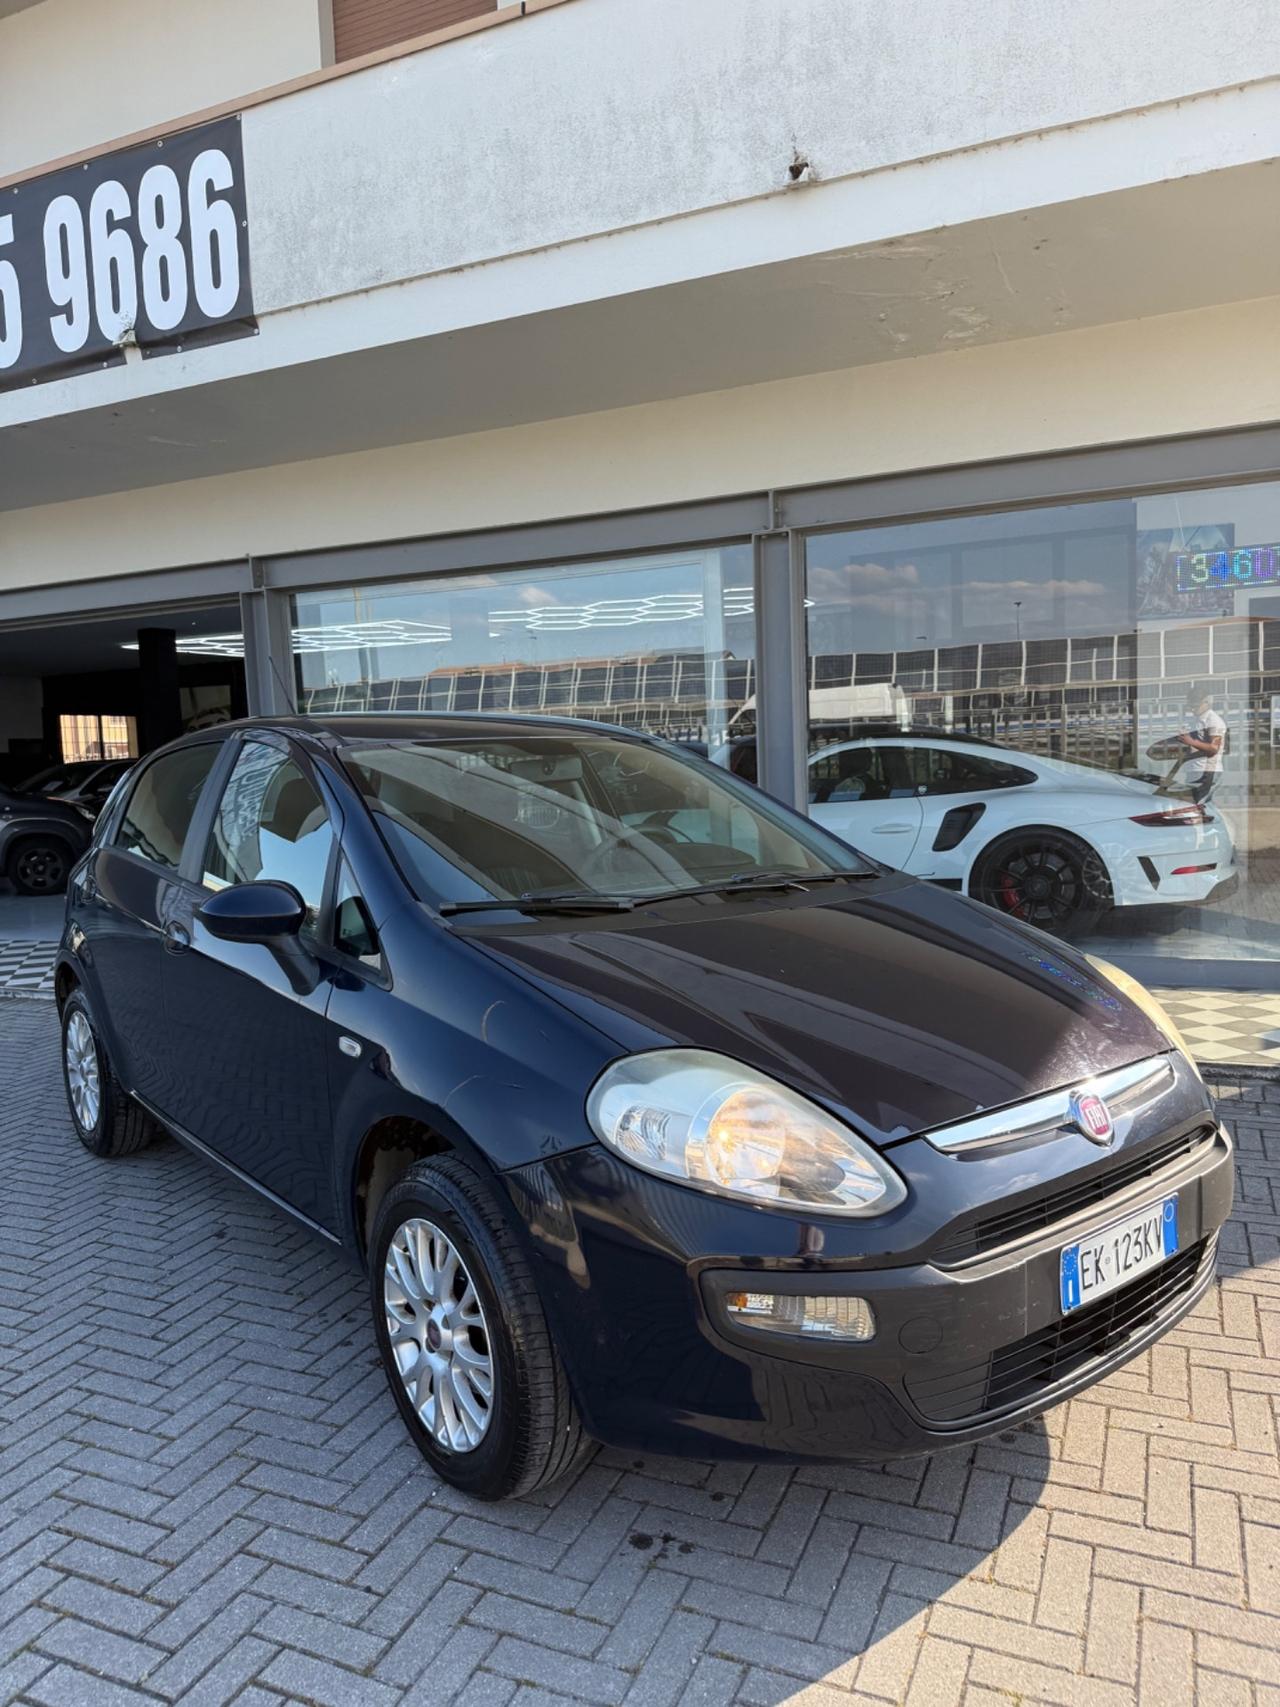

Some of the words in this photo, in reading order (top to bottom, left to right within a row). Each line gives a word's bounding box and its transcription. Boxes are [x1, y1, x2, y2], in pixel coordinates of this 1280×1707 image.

[43, 148, 240, 353] 9686
[1191, 547, 1280, 582] 3460
[1081, 1245, 1106, 1290] EK
[1113, 1215, 1163, 1275] 123KV
